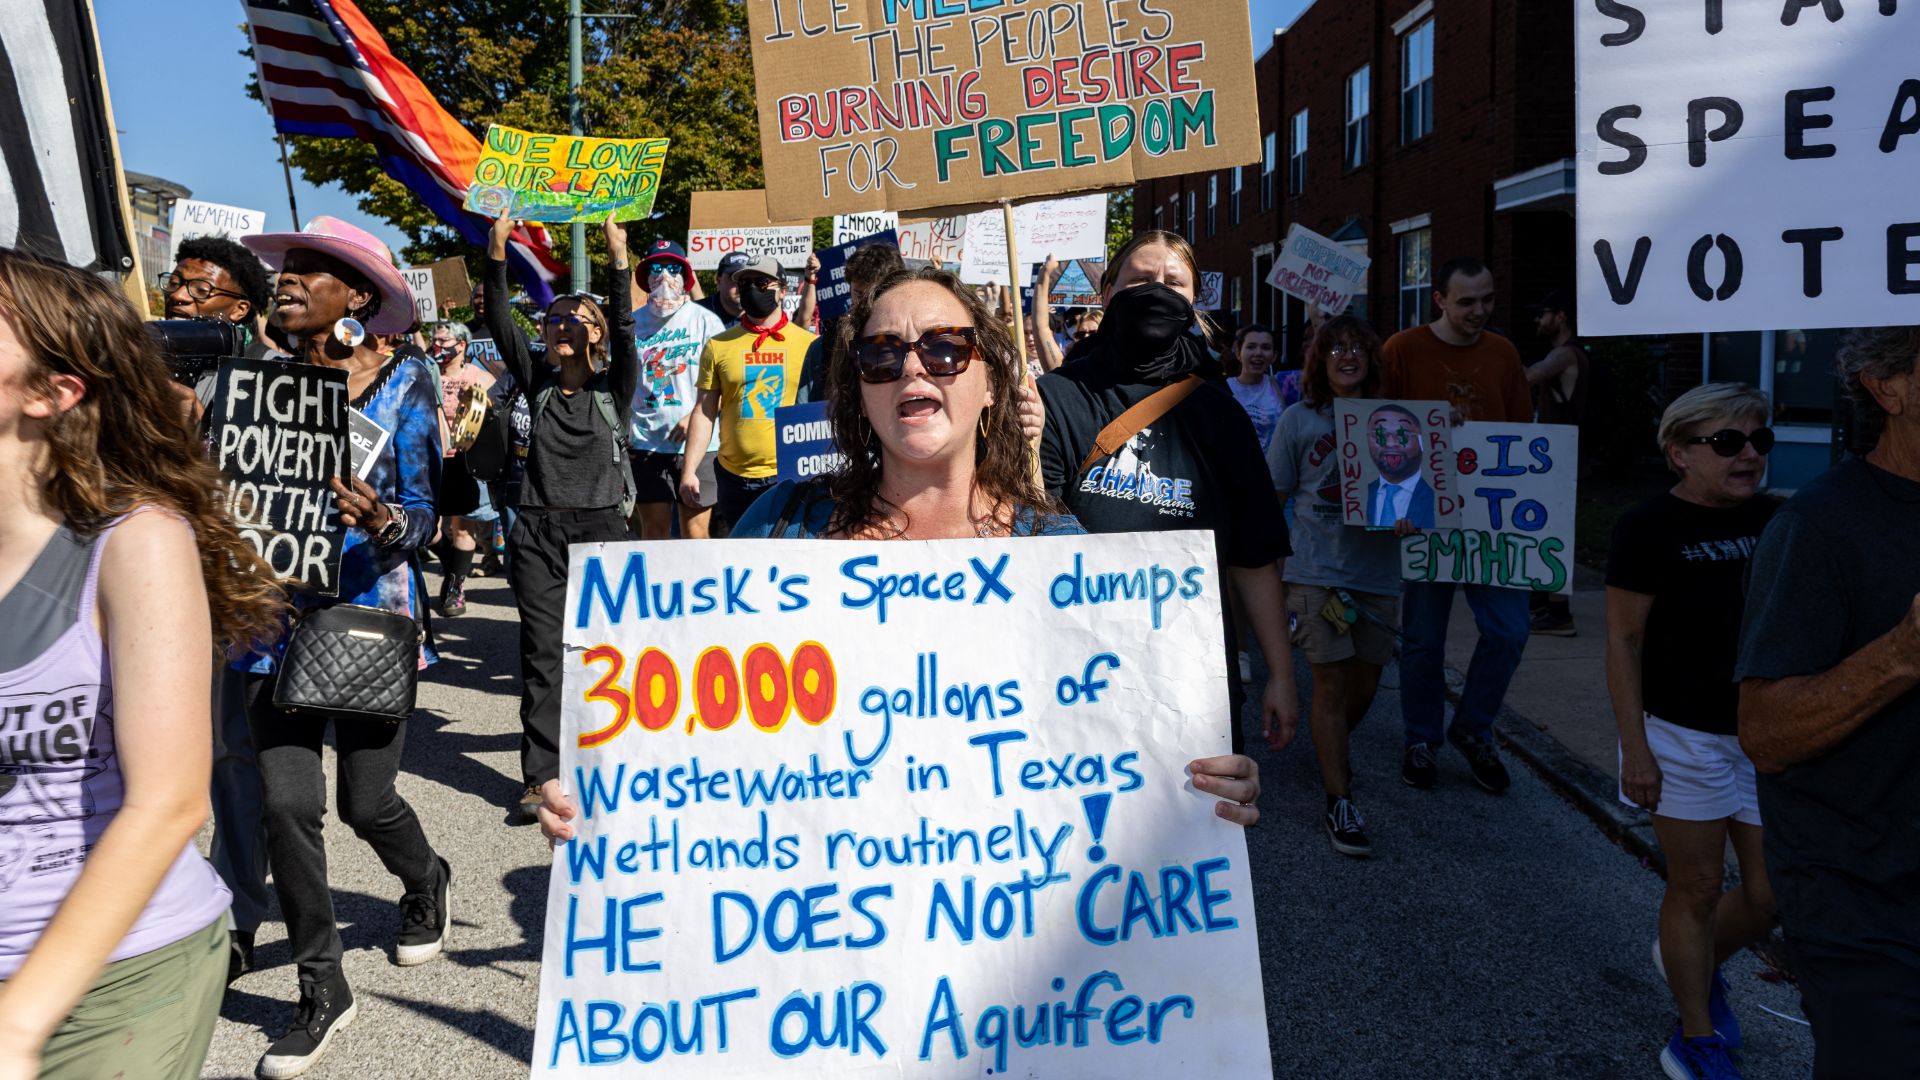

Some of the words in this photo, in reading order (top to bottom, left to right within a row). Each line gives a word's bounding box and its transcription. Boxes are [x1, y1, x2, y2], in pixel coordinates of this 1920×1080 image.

[853, 21, 956, 83] THE
[970, 0, 1173, 68] PEOPLES
[777, 71, 988, 143] BURNING
[1022, 42, 1204, 110] DESIRE
[487, 126, 556, 163] WE
[566, 139, 670, 171] LOVE
[819, 137, 917, 198] FOR
[934, 89, 1217, 184] FREEDOM
[475, 157, 556, 193] OUR
[566, 171, 658, 198] LAND
[183, 204, 251, 230] MEMPHIS
[691, 236, 744, 252] STOP
[764, 245, 806, 255] FUTURE
[1593, 222, 1920, 305] VOTE
[402, 271, 428, 291] MP
[817, 286, 834, 301] FOR
[1302, 263, 1334, 282] NOT
[744, 352, 784, 365] stax
[226, 368, 346, 428] FIGHT
[219, 423, 346, 482] POVERTY
[1481, 434, 1553, 476] IS
[1086, 465, 1193, 502] CHANGE
[1140, 492, 1196, 511] Obama
[284, 486, 340, 533] THE
[236, 529, 332, 588] OOR
[575, 551, 811, 630] Musk's
[839, 552, 1015, 625] SpaceX
[1050, 552, 1205, 631] dumps
[43, 694, 87, 725] OF
[577, 640, 838, 749] 30,000
[843, 650, 1025, 768] gallons
[1056, 651, 1121, 706] of
[0, 717, 99, 765] HIS!
[906, 754, 951, 795] in
[967, 730, 1146, 798] Texas
[567, 809, 801, 886] Wetlands
[564, 892, 665, 979] HE
[712, 883, 895, 964] DOES
[925, 868, 1046, 945] NOT
[1075, 857, 1240, 947] CARE
[548, 987, 761, 1070] ABOUT
[768, 980, 888, 1060] OUR
[918, 970, 1195, 1074] Aquifer
